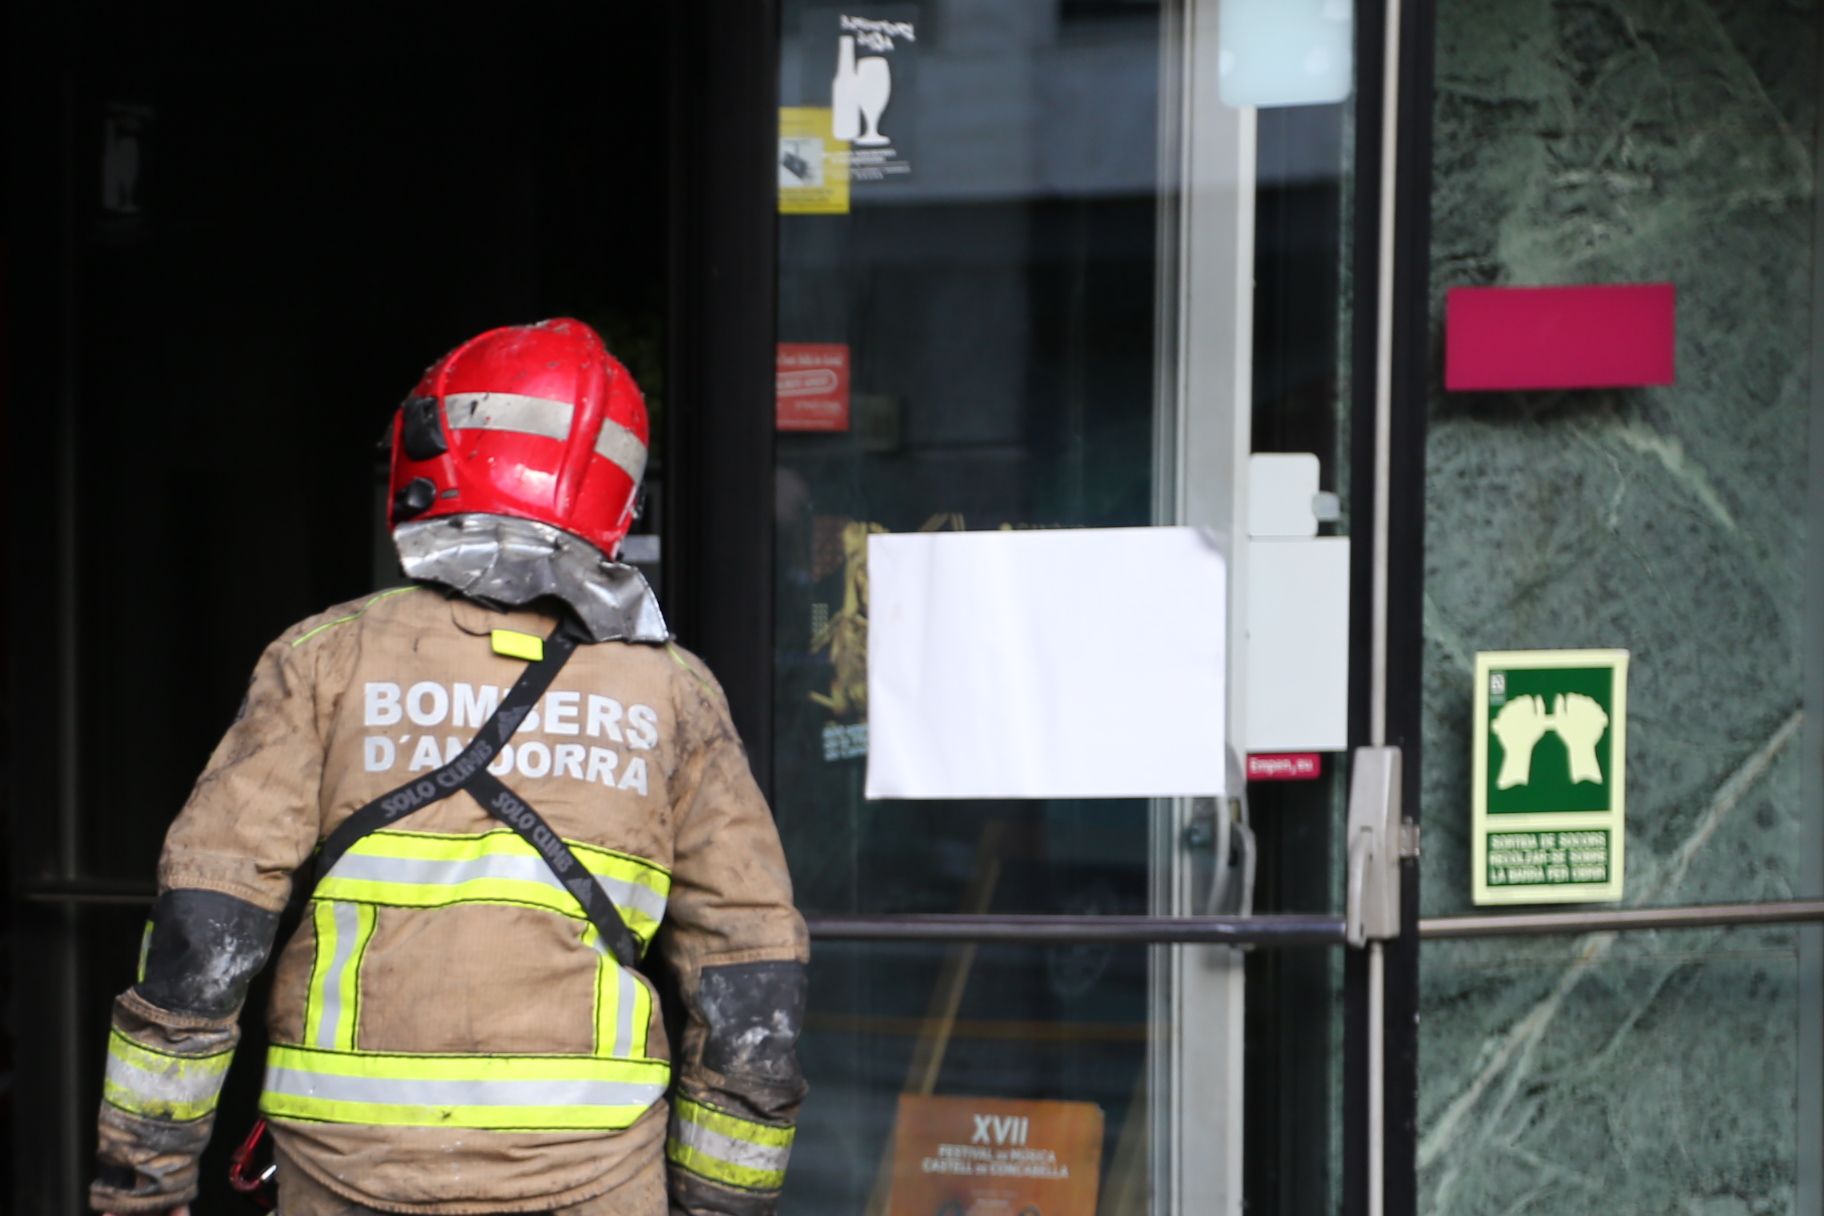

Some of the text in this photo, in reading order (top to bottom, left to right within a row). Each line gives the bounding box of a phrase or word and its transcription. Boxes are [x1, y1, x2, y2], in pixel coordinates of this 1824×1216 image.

[381, 740, 492, 818] SOLO CLIMB
[492, 792, 574, 872] SOLO CLIMB
[1540, 833, 1556, 848] DE
[971, 1113, 1029, 1145] XVII
[938, 1144, 993, 1160] FESTIVAL
[922, 1157, 973, 1174] CASTELL
